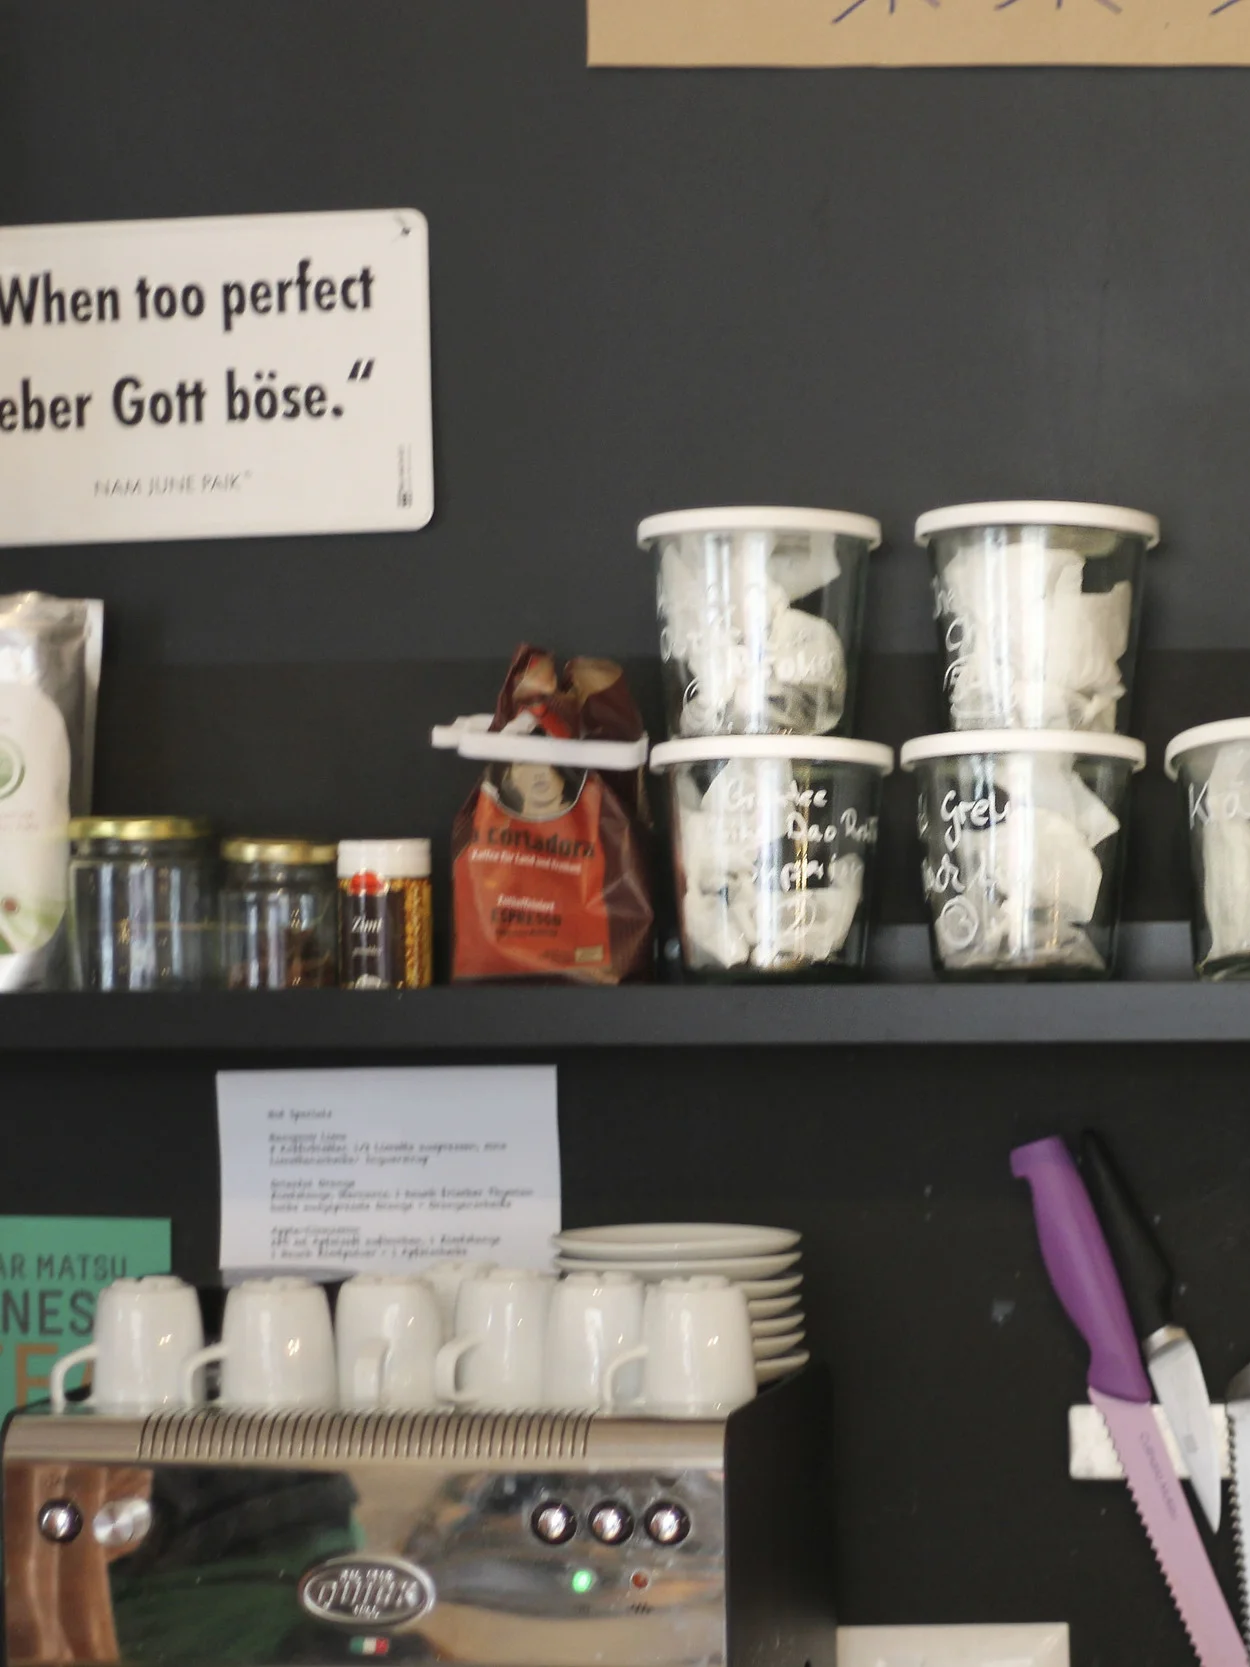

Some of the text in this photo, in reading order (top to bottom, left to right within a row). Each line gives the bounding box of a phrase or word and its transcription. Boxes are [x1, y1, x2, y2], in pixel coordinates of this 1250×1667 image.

[0, 257, 375, 333] When too perfect
[0, 377, 92, 432] eber
[112, 376, 207, 427] Gott
[94, 477, 142, 498] NAM
[148, 474, 197, 496] JUNE
[36, 1253, 127, 1280] MATSU
